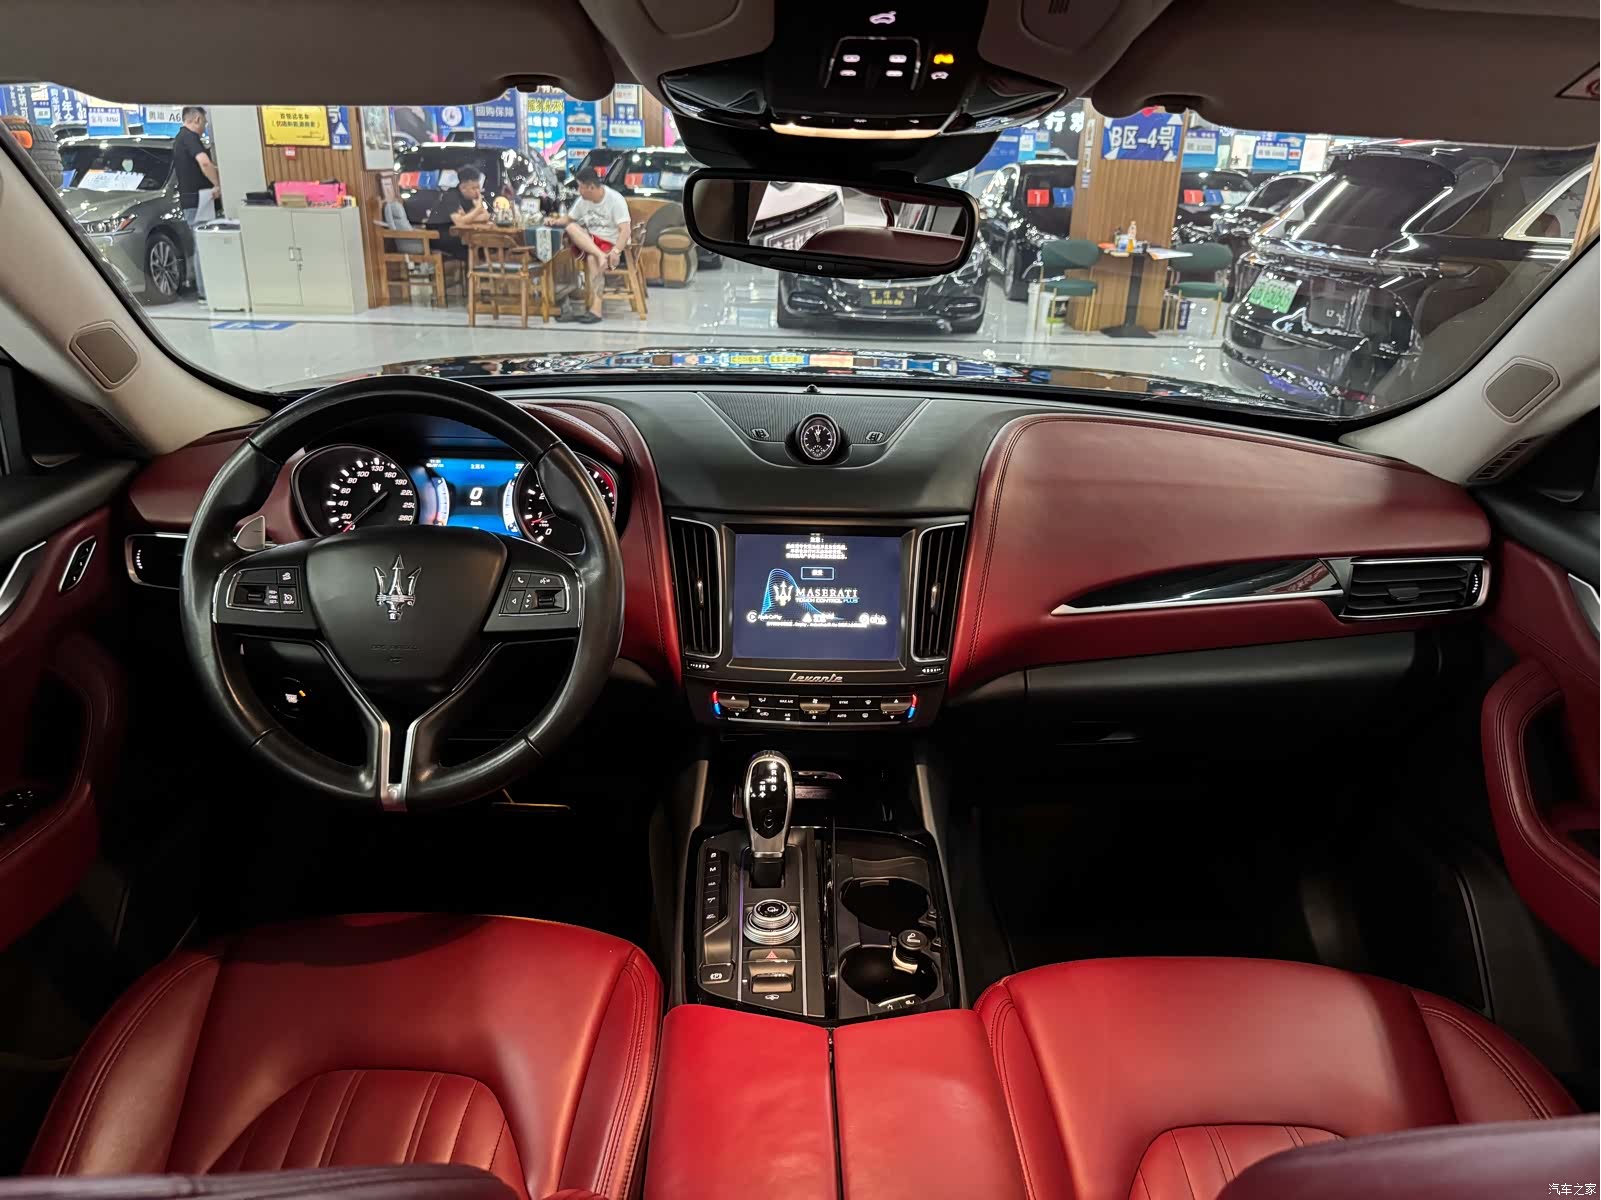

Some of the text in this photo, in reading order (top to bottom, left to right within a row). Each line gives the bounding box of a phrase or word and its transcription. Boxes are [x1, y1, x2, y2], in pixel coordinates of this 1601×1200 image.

[475, 106, 514, 117] 回购保障
[1111, 126, 1173, 151] B区-4号
[469, 487, 483, 500] 0
[795, 588, 858, 598] MASERATI
[788, 672, 843, 684] Levante
